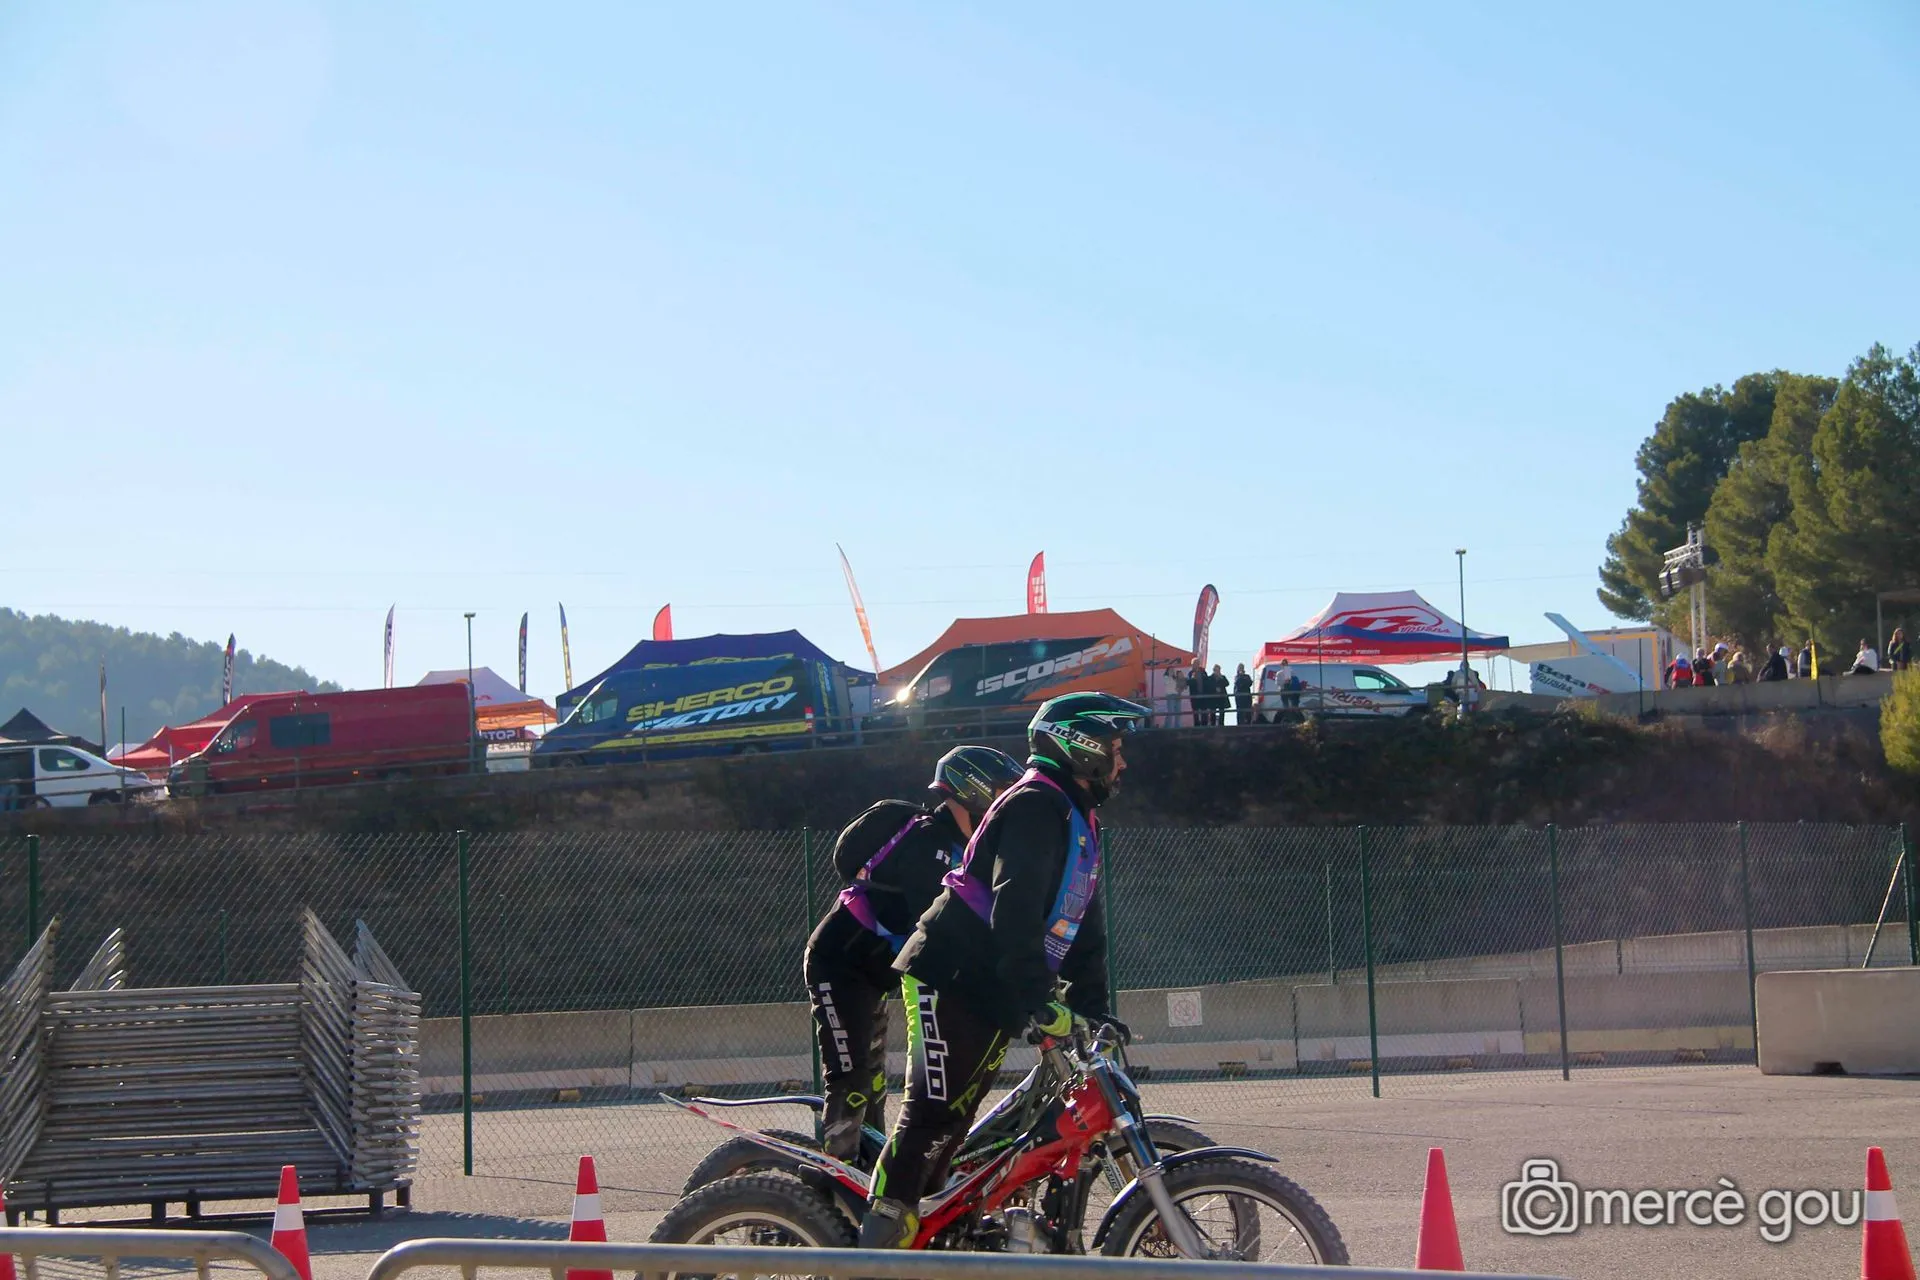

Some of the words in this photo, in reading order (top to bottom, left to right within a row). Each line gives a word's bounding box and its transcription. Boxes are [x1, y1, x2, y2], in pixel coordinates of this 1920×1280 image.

[975, 636, 1134, 697] SCORPA
[626, 676, 794, 722] SHERCO
[632, 692, 798, 731] FACTORY
[917, 985, 949, 1101] hebo
